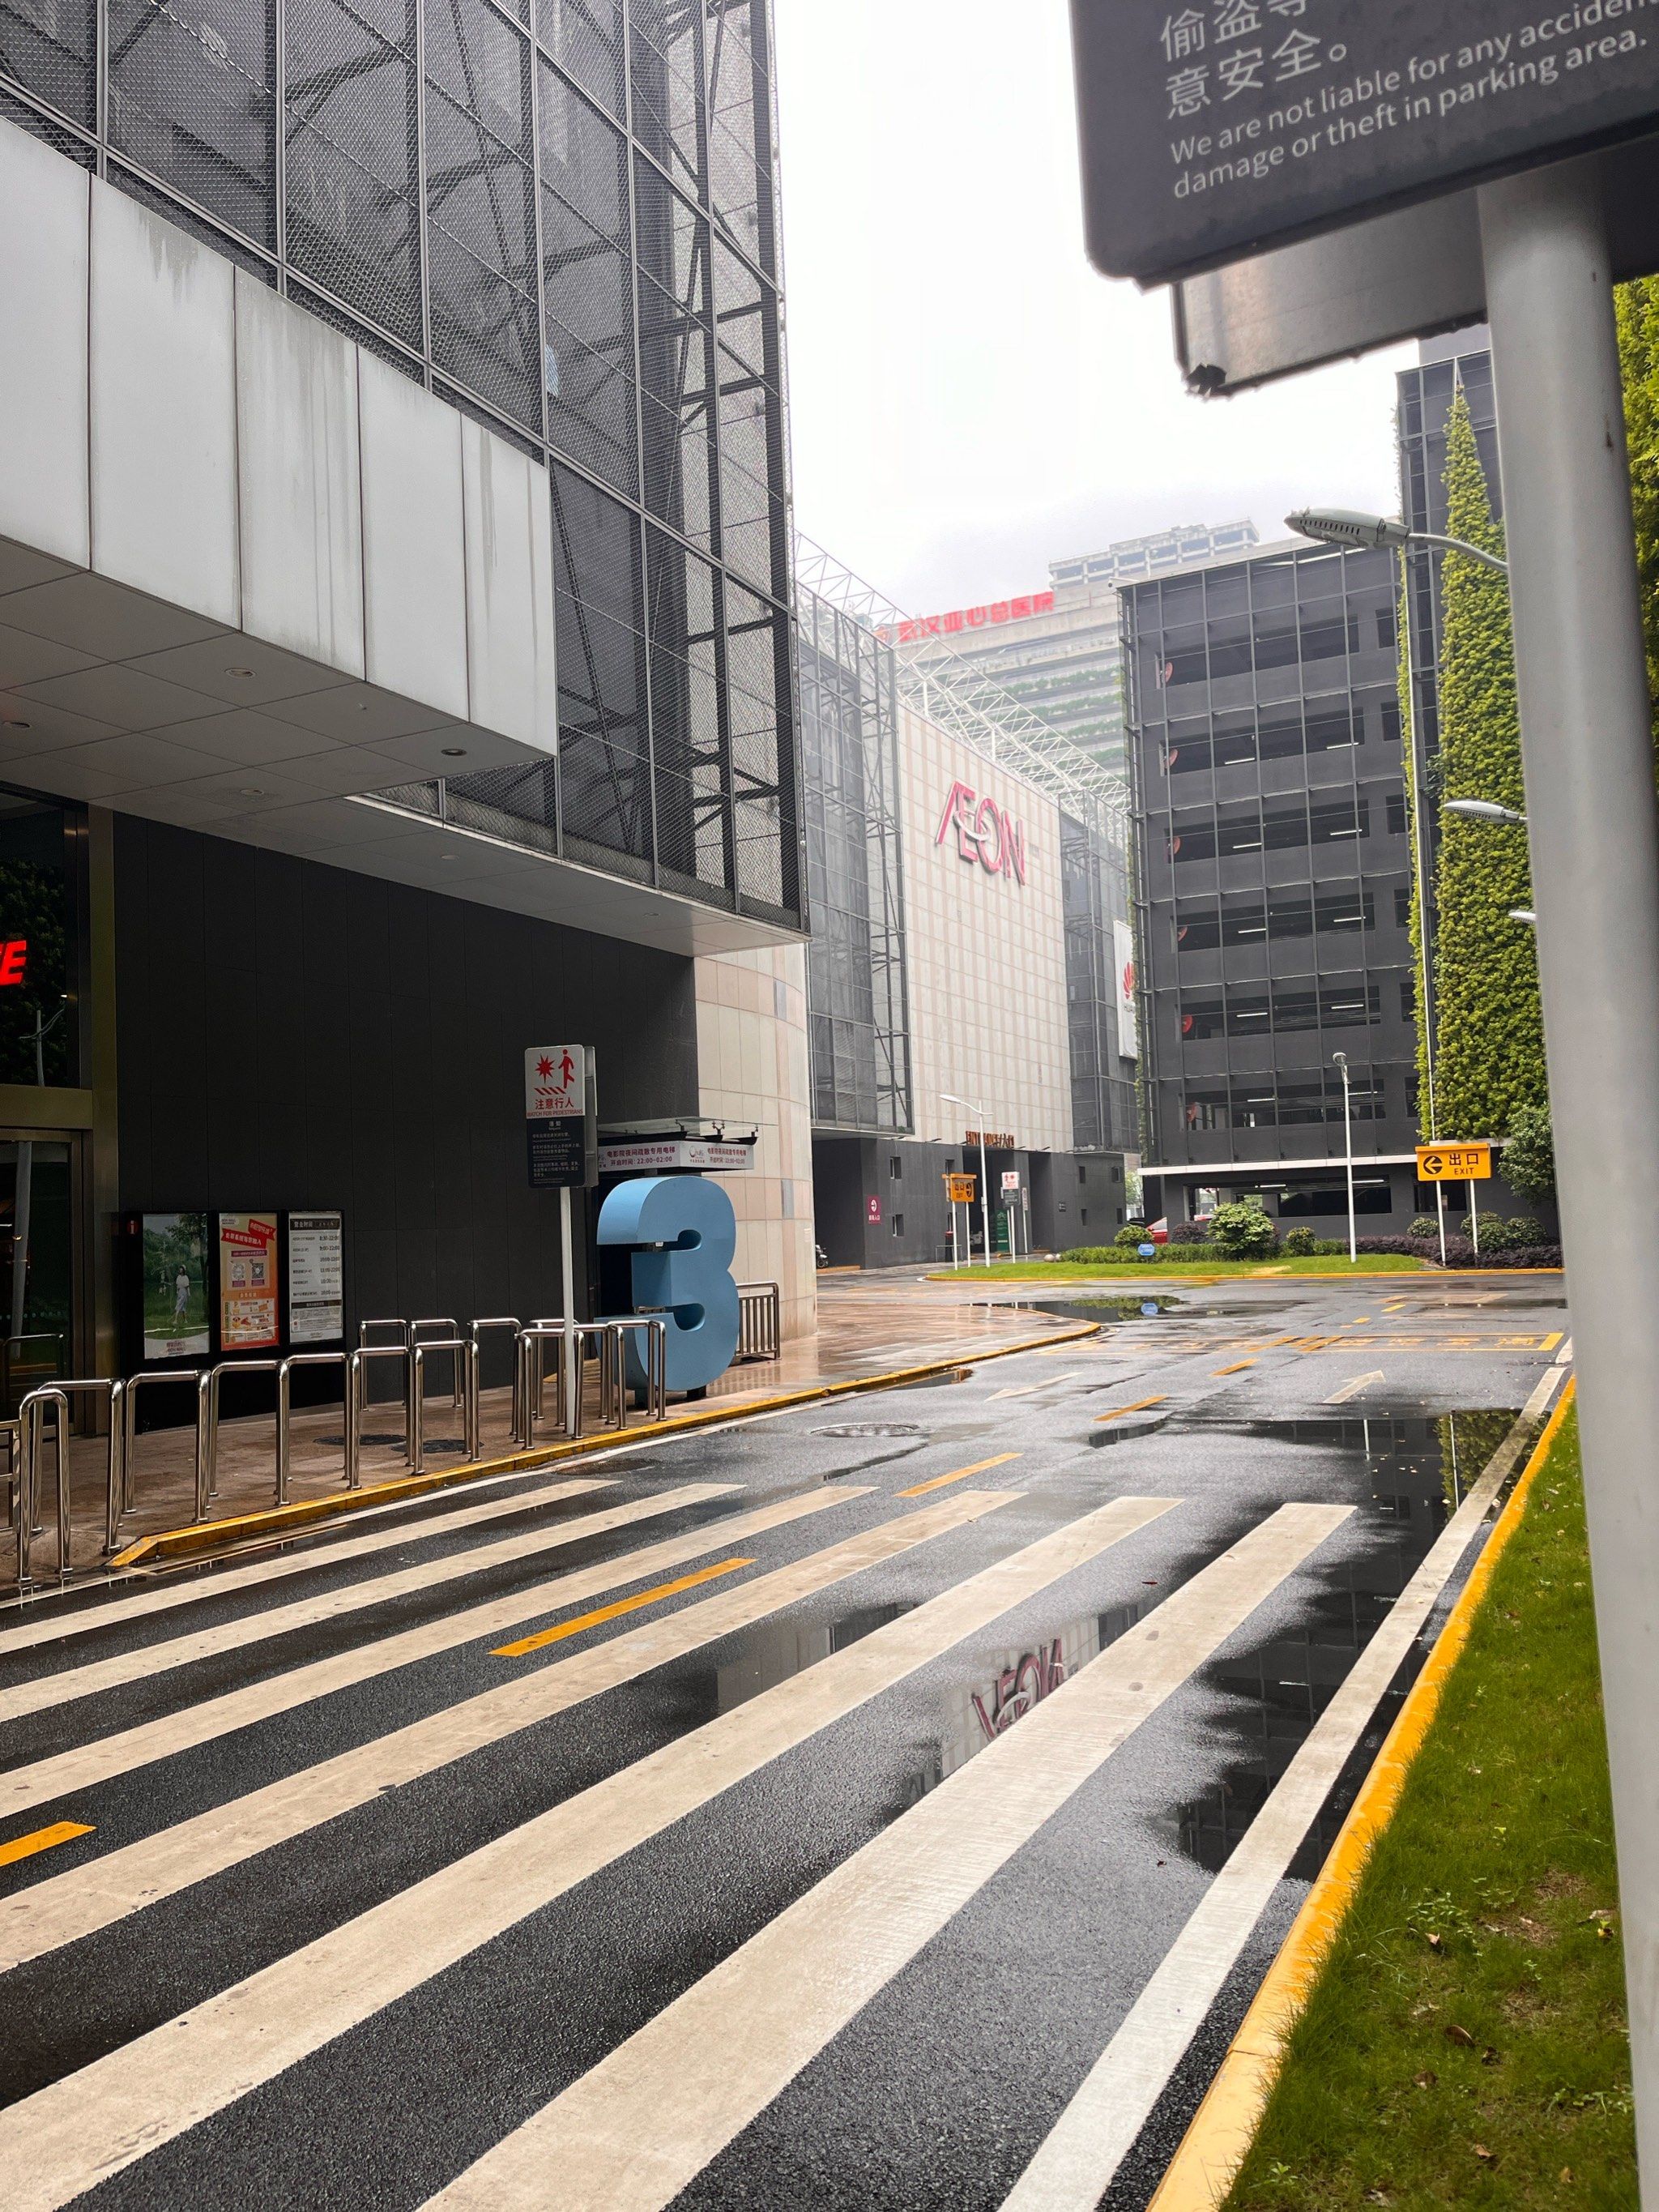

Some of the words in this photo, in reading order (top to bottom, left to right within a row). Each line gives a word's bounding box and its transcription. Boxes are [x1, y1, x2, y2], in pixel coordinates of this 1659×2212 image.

[1166, 28, 1347, 119] 意安全。
[1171, 135, 1212, 164] We
[1218, 117, 1261, 149] are
[1268, 96, 1316, 131] not
[1320, 70, 1401, 113] liable
[1407, 56, 1450, 84] for
[1457, 32, 1512, 68] any
[1174, 145, 1285, 199] damage
[1291, 131, 1321, 157] or
[1326, 102, 1397, 147] theft
[1404, 96, 1431, 122] in
[1438, 54, 1559, 117] parking
[1565, 29, 1648, 70] area.
[535, 1097, 574, 1110] 注意行人
[1448, 1153, 1478, 1166] 出口
[1454, 1167, 1474, 1175] EXIT
[594, 1176, 740, 1392] 3
